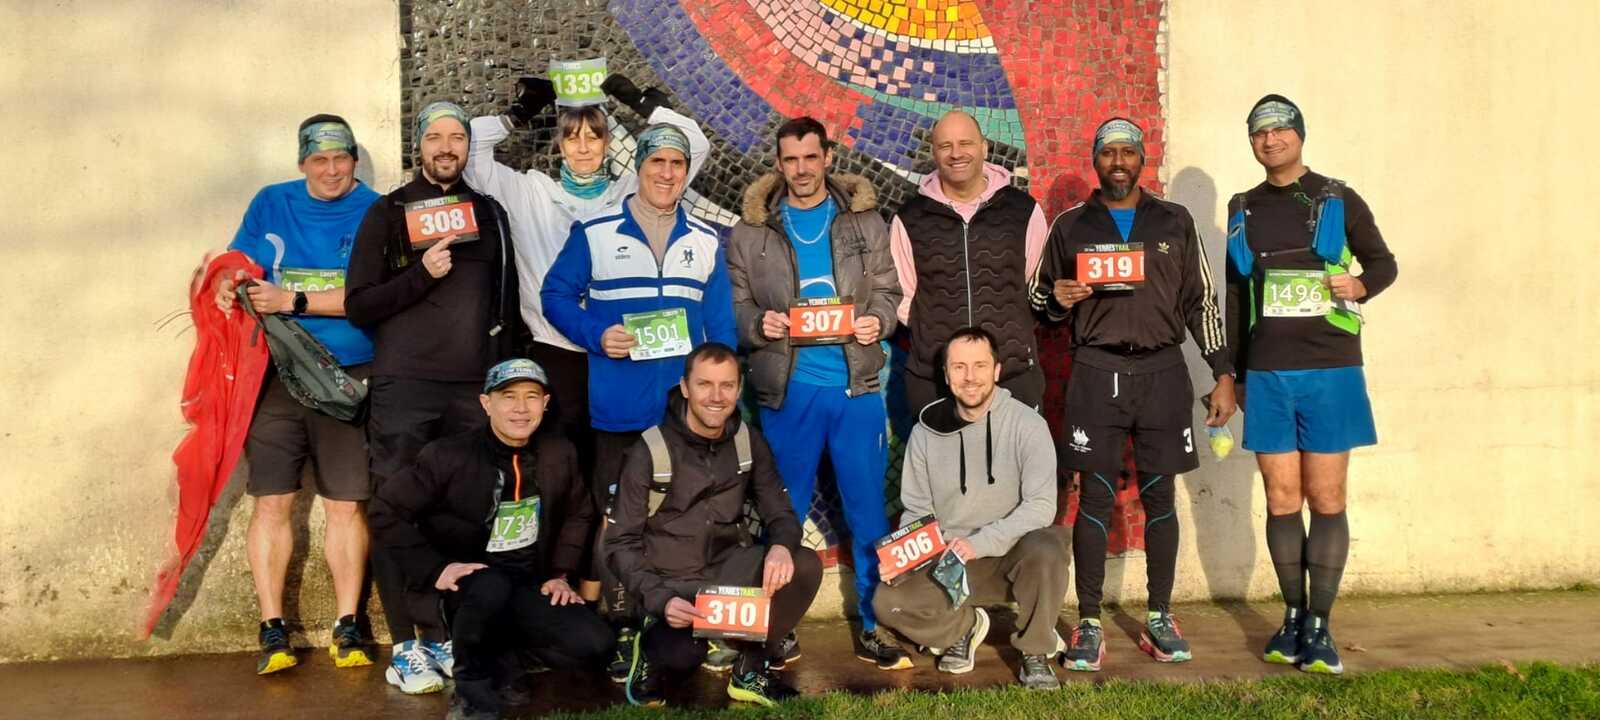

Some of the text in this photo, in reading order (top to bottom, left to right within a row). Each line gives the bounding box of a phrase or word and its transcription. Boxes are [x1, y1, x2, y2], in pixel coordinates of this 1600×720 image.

[553, 72, 605, 95] 1339
[419, 208, 466, 236] 308
[1088, 255, 1133, 279] 319
[1271, 284, 1322, 302] 1496
[801, 309, 844, 333] 307
[635, 323, 679, 346] 1501
[1183, 427, 1194, 453] 3
[494, 511, 537, 537] 1734
[891, 531, 934, 569] 306
[707, 599, 757, 627] 310
